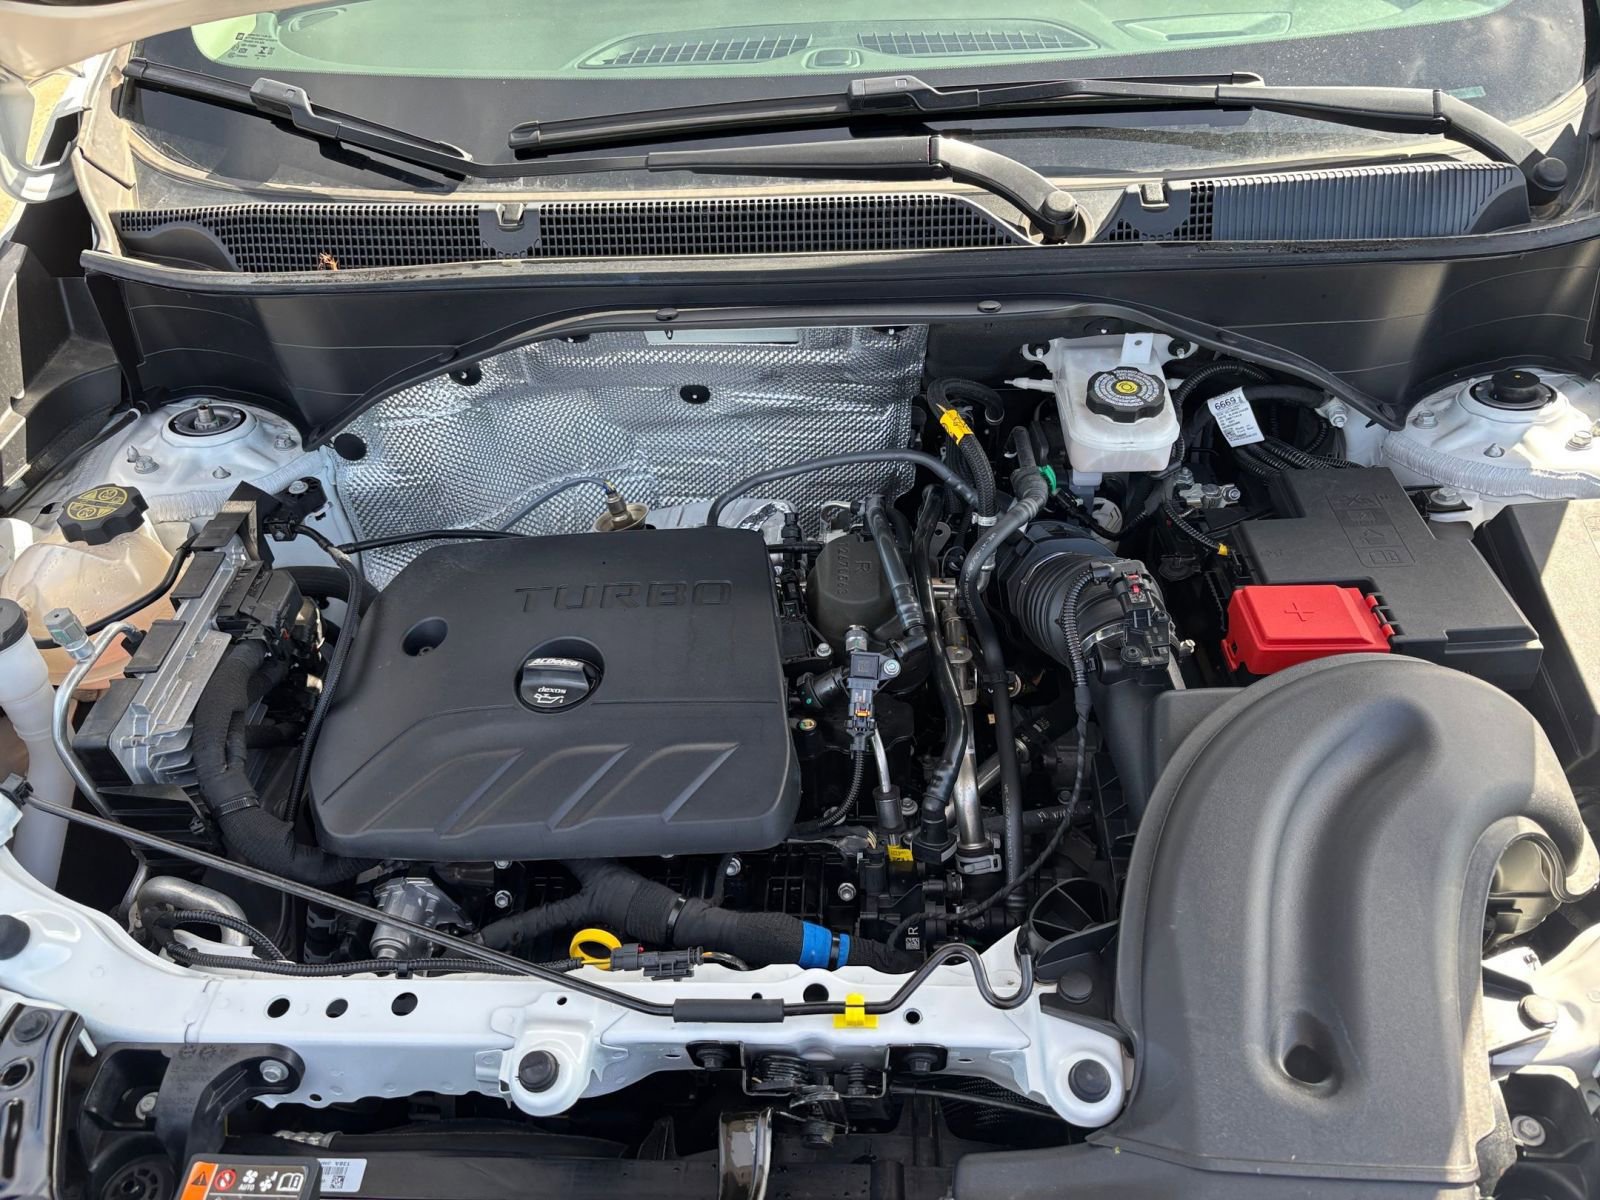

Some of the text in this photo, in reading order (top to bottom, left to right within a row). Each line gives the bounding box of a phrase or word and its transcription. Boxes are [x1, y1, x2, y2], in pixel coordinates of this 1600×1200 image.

[1214, 396, 1237, 411] 6669
[855, 560, 873, 574] R
[514, 579, 733, 612] TURBO
[527, 657, 579, 667] ACDelco
[537, 685, 567, 694] dexos
[907, 926, 919, 935] R
[239, 1183, 255, 1192] AUTO
